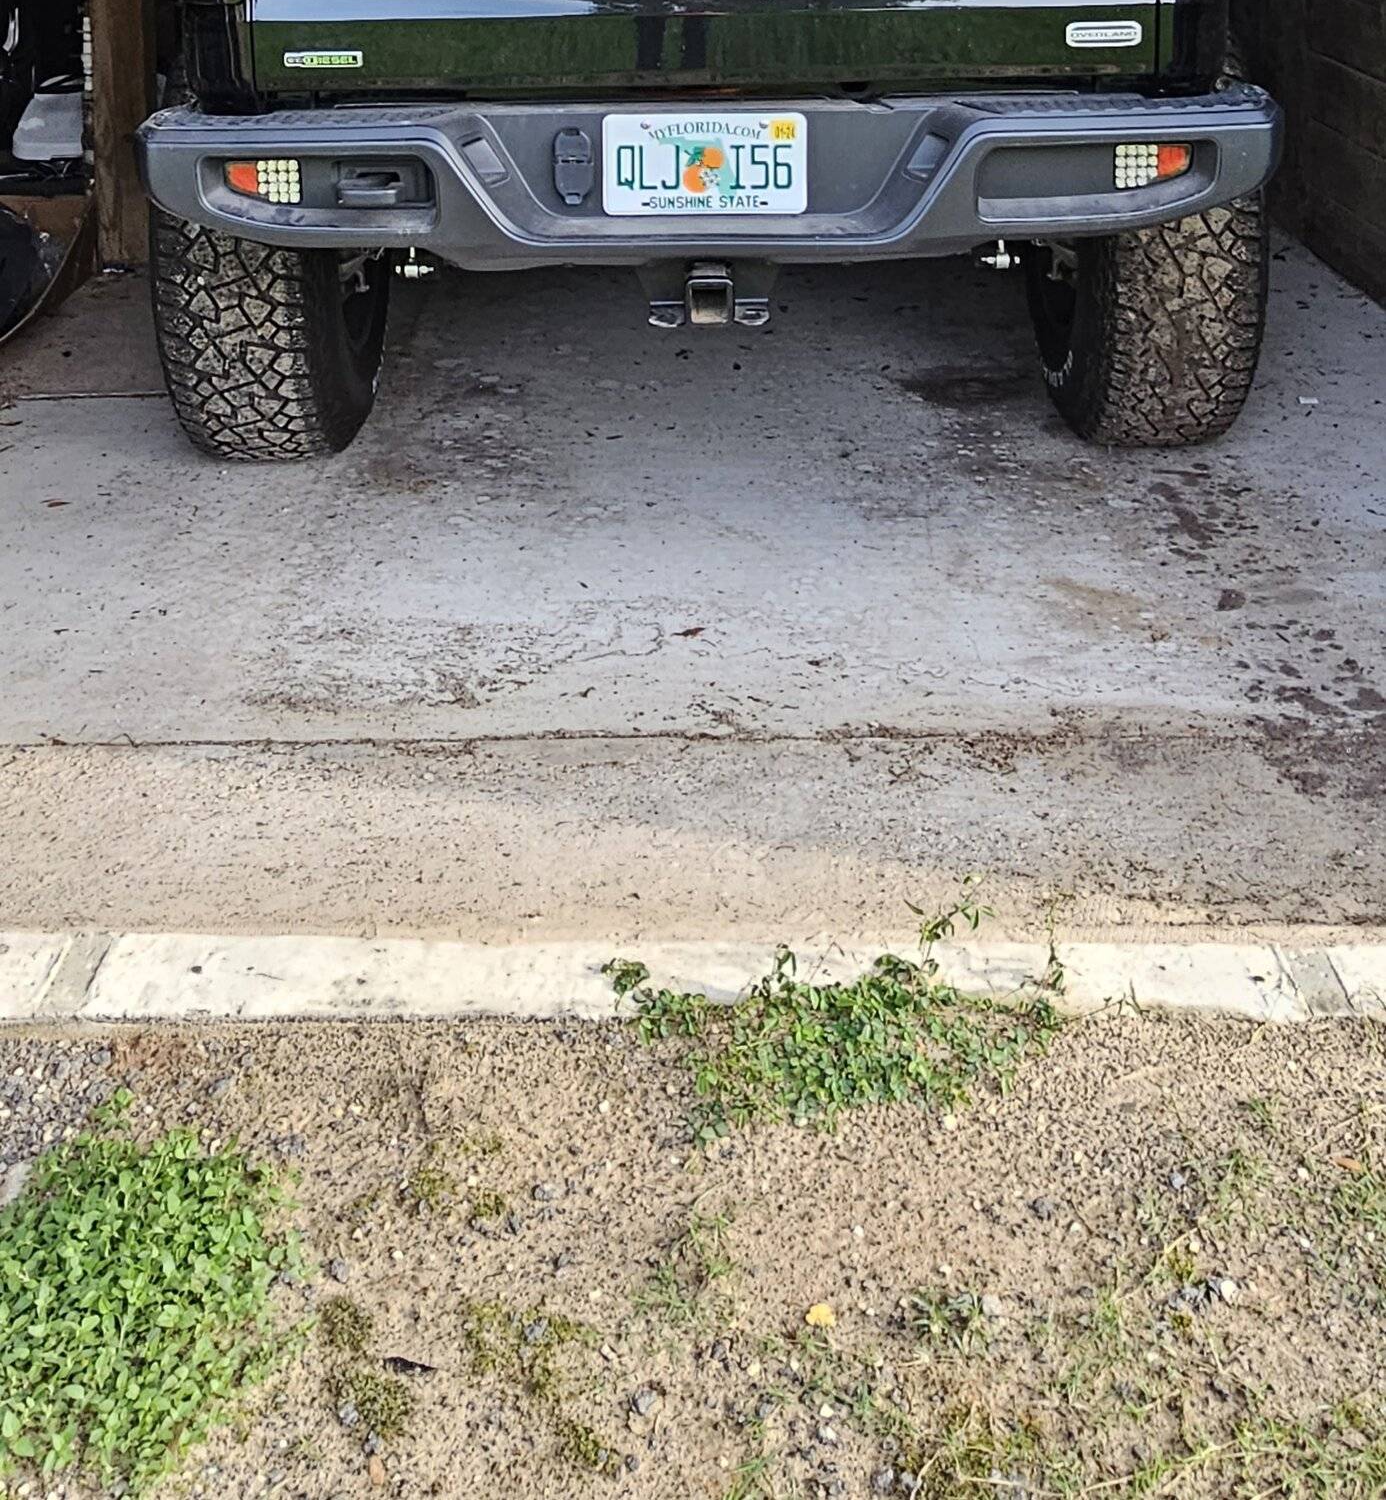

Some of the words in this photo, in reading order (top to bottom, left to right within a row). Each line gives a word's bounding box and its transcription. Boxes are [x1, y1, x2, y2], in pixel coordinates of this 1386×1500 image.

[1070, 29, 1137, 38] OVERLAND
[616, 145, 681, 190] QLJ
[729, 144, 793, 190] I56
[649, 196, 712, 209] SUNSHINE
[719, 195, 760, 208] STATE
